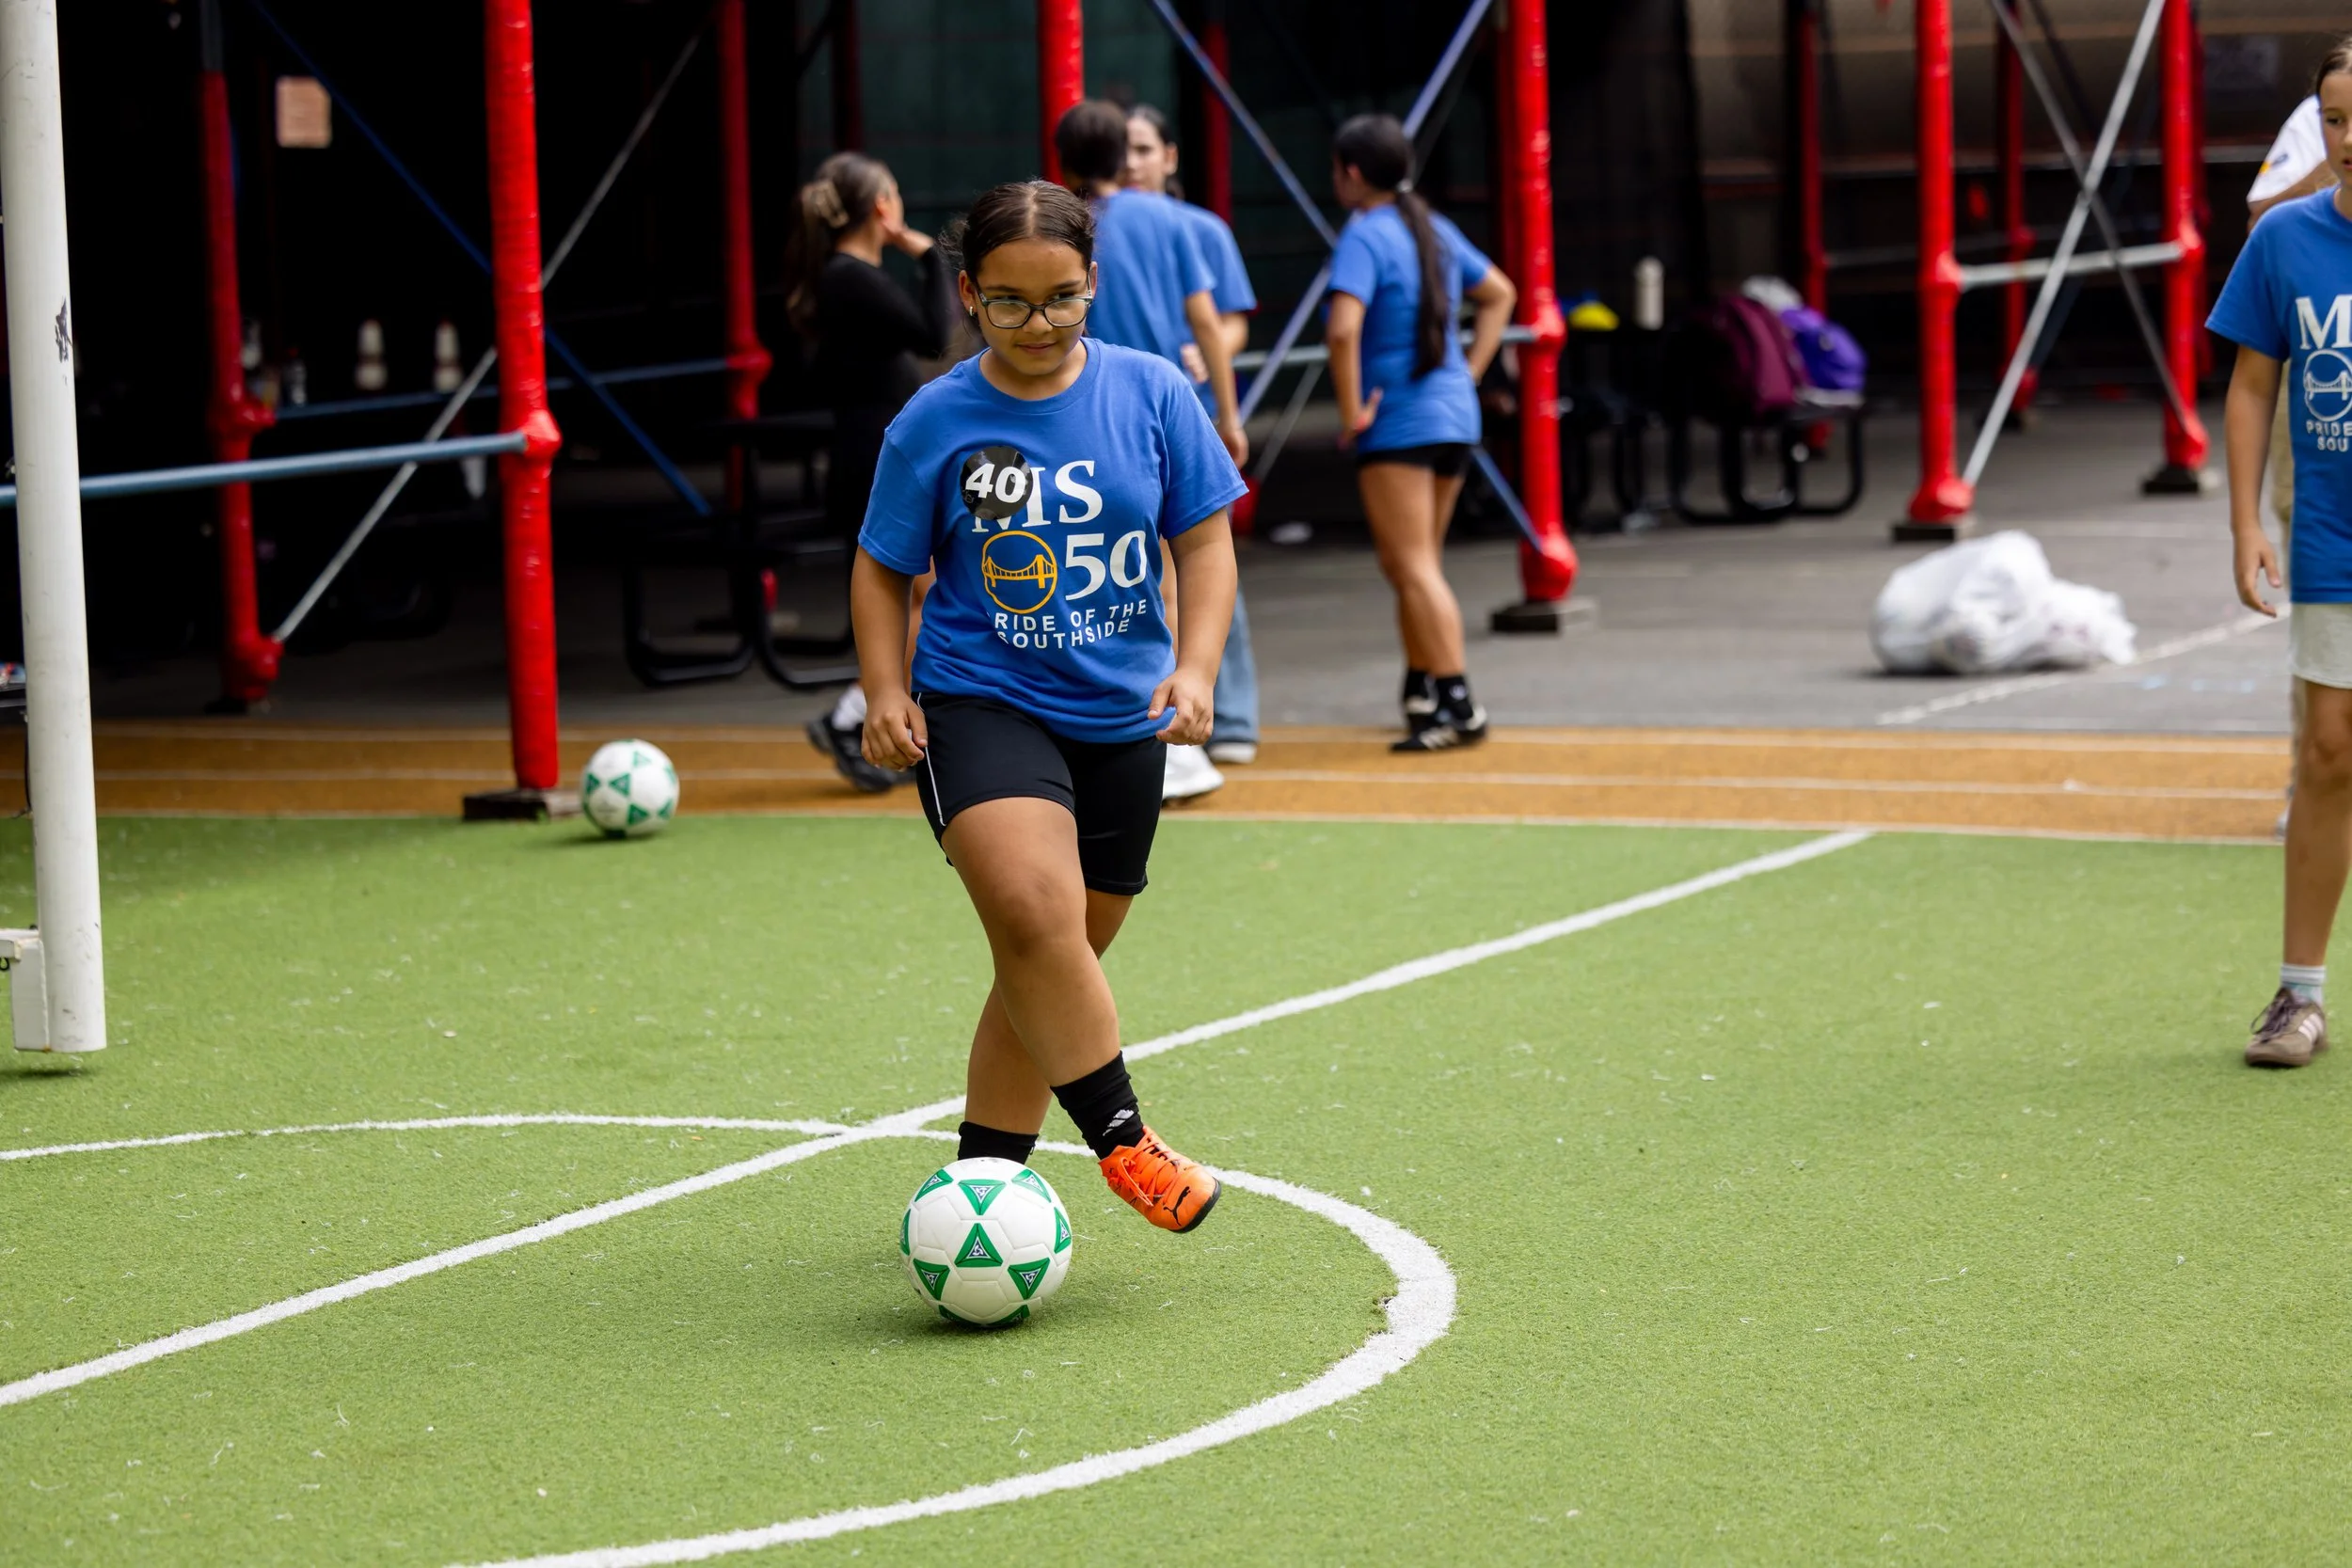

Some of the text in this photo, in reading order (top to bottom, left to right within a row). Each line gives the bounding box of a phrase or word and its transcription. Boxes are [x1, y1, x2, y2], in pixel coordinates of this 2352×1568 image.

[2306, 420, 2352, 437] PRIDE
[965, 463, 1026, 503] 40
[1065, 530, 1147, 601] 50
[987, 598, 1147, 632] RIDE OF THE
